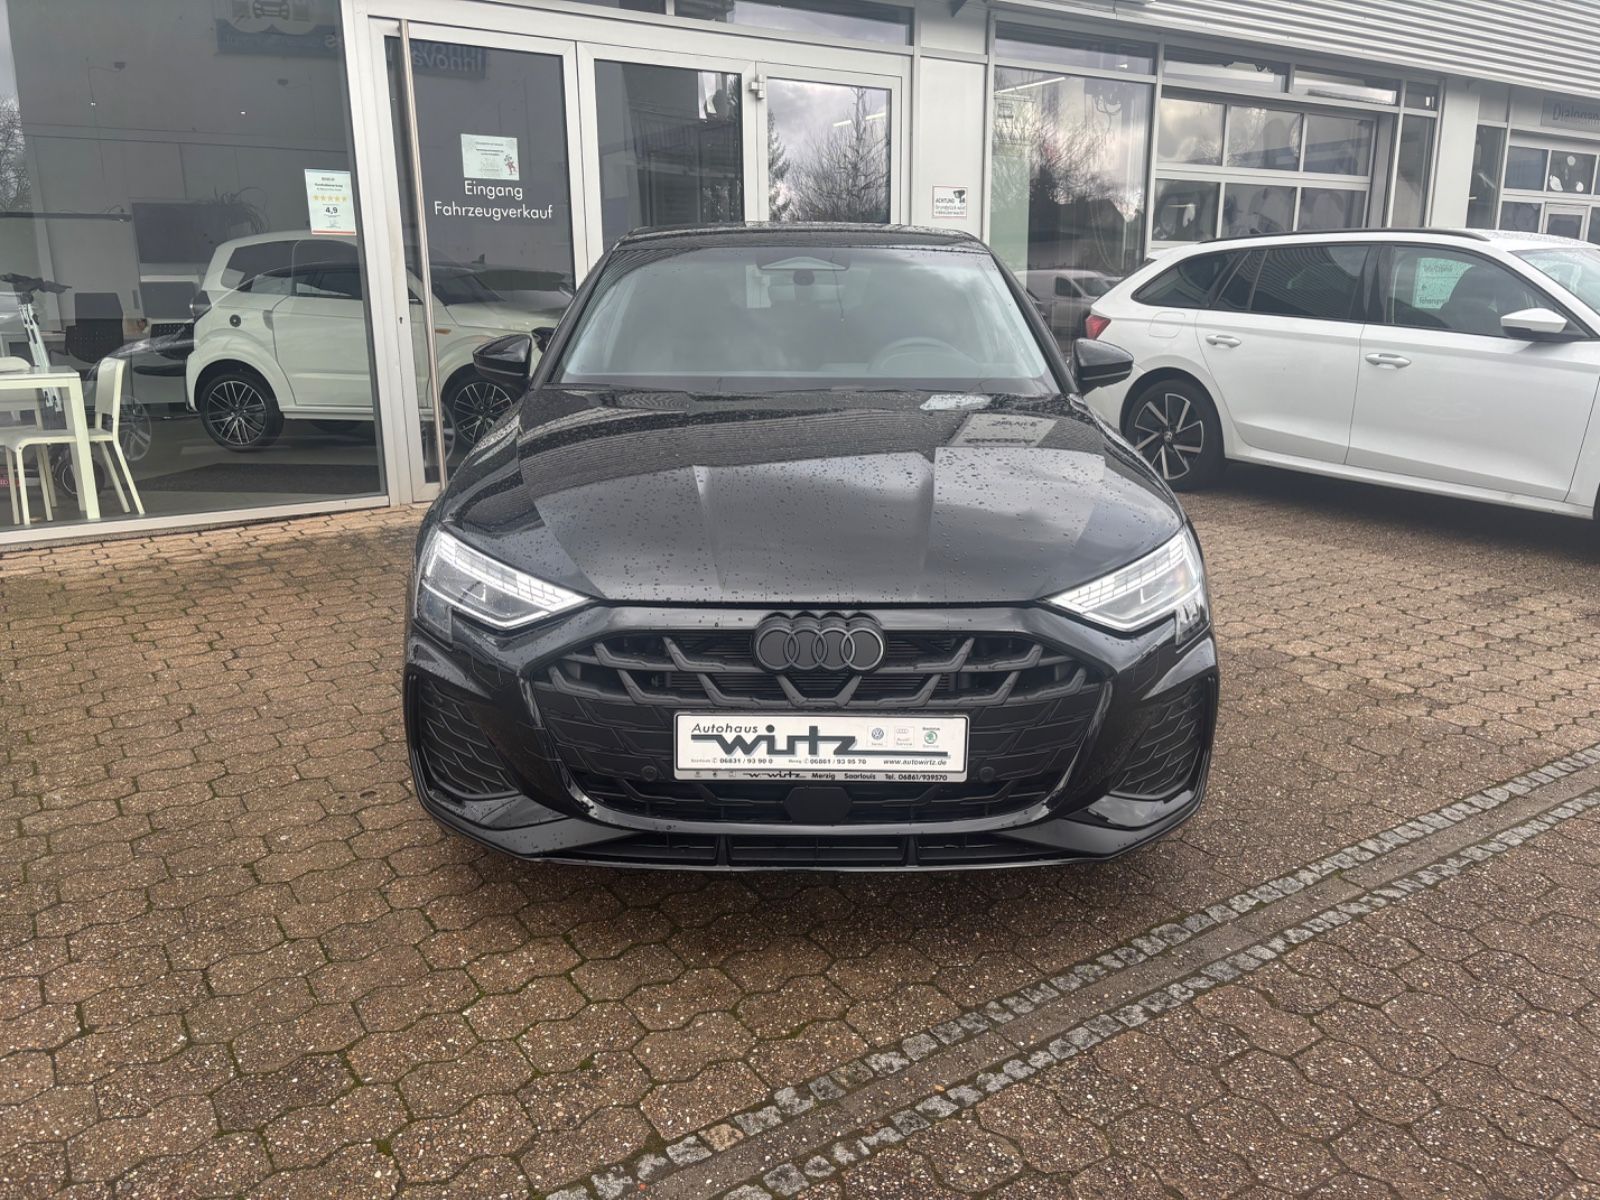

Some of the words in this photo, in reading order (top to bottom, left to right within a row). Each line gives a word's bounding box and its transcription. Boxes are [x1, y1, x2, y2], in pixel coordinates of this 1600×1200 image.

[464, 180, 523, 201] Eingang
[325, 206, 338, 215] 4,9
[434, 200, 553, 221] Fahrzeugverkauf
[691, 723, 759, 734] Autohaus
[691, 725, 948, 757] wirtz
[811, 772, 836, 780] Merzig
